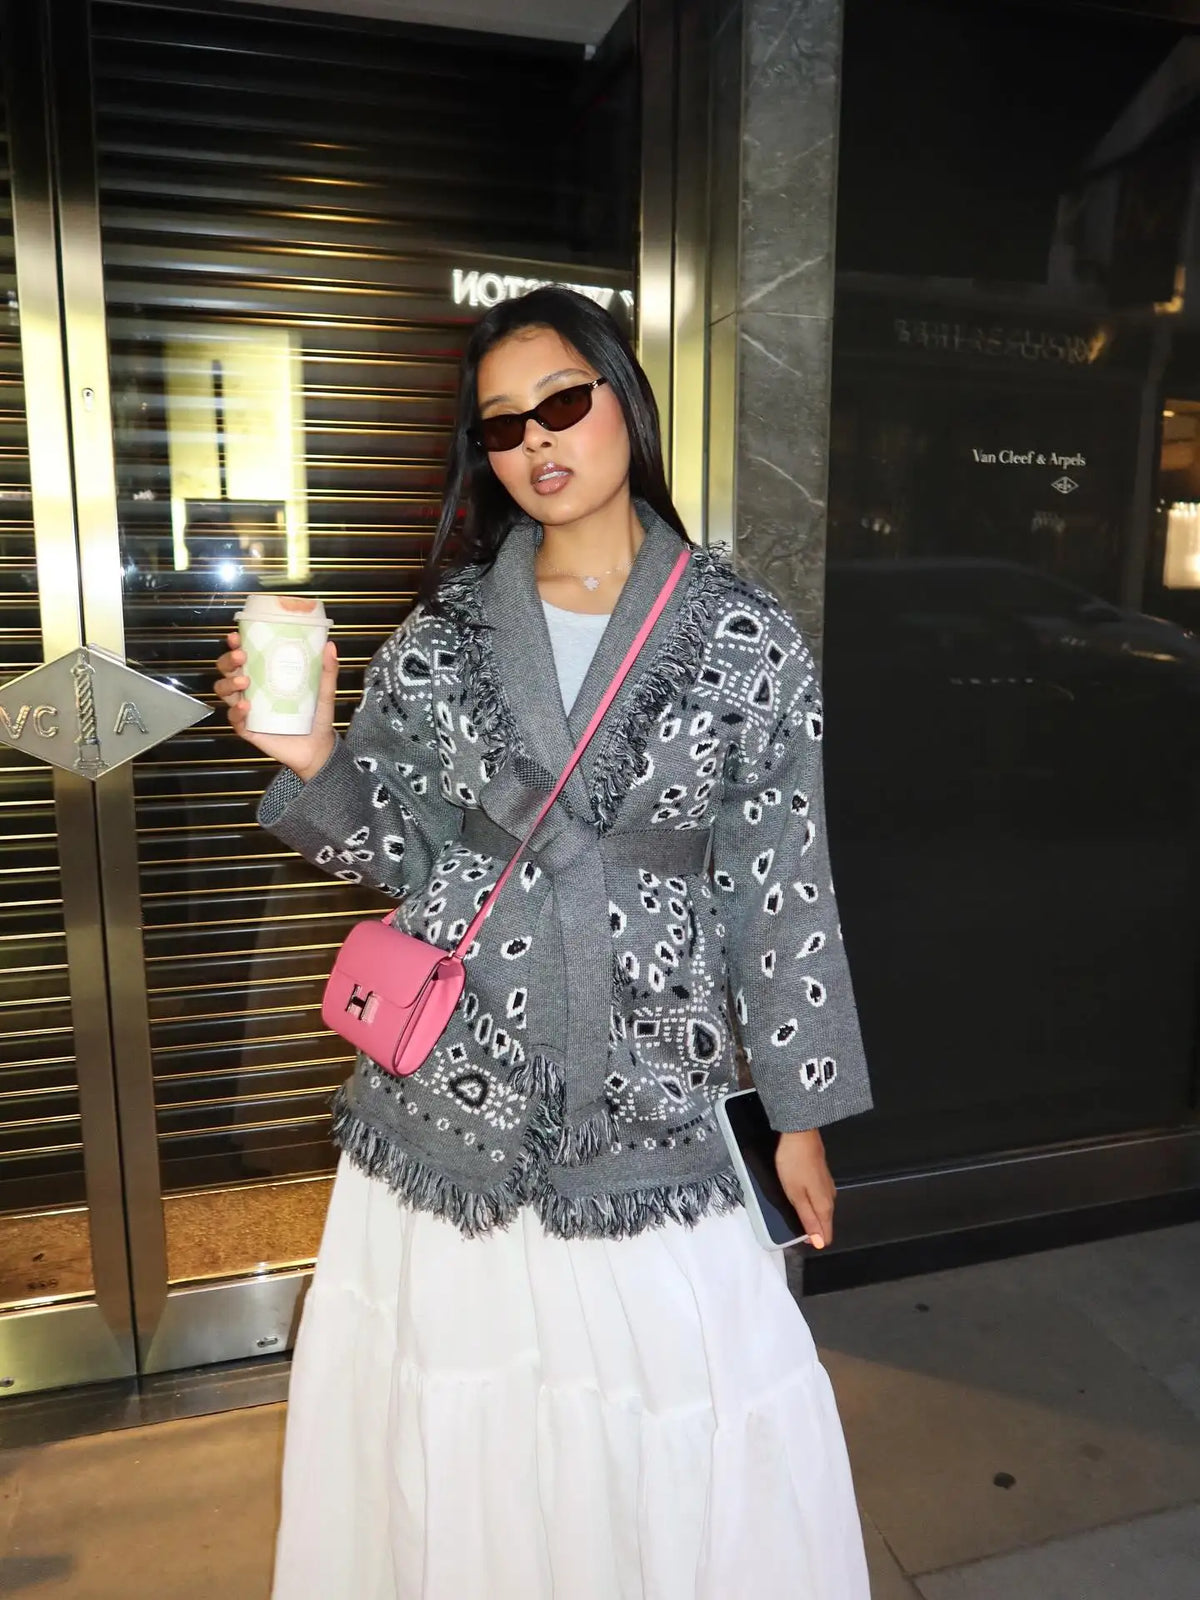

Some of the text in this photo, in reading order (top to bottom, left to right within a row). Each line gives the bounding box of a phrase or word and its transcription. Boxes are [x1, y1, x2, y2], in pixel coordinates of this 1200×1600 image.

[972, 448, 1086, 470] Van Cleef & Arpels
